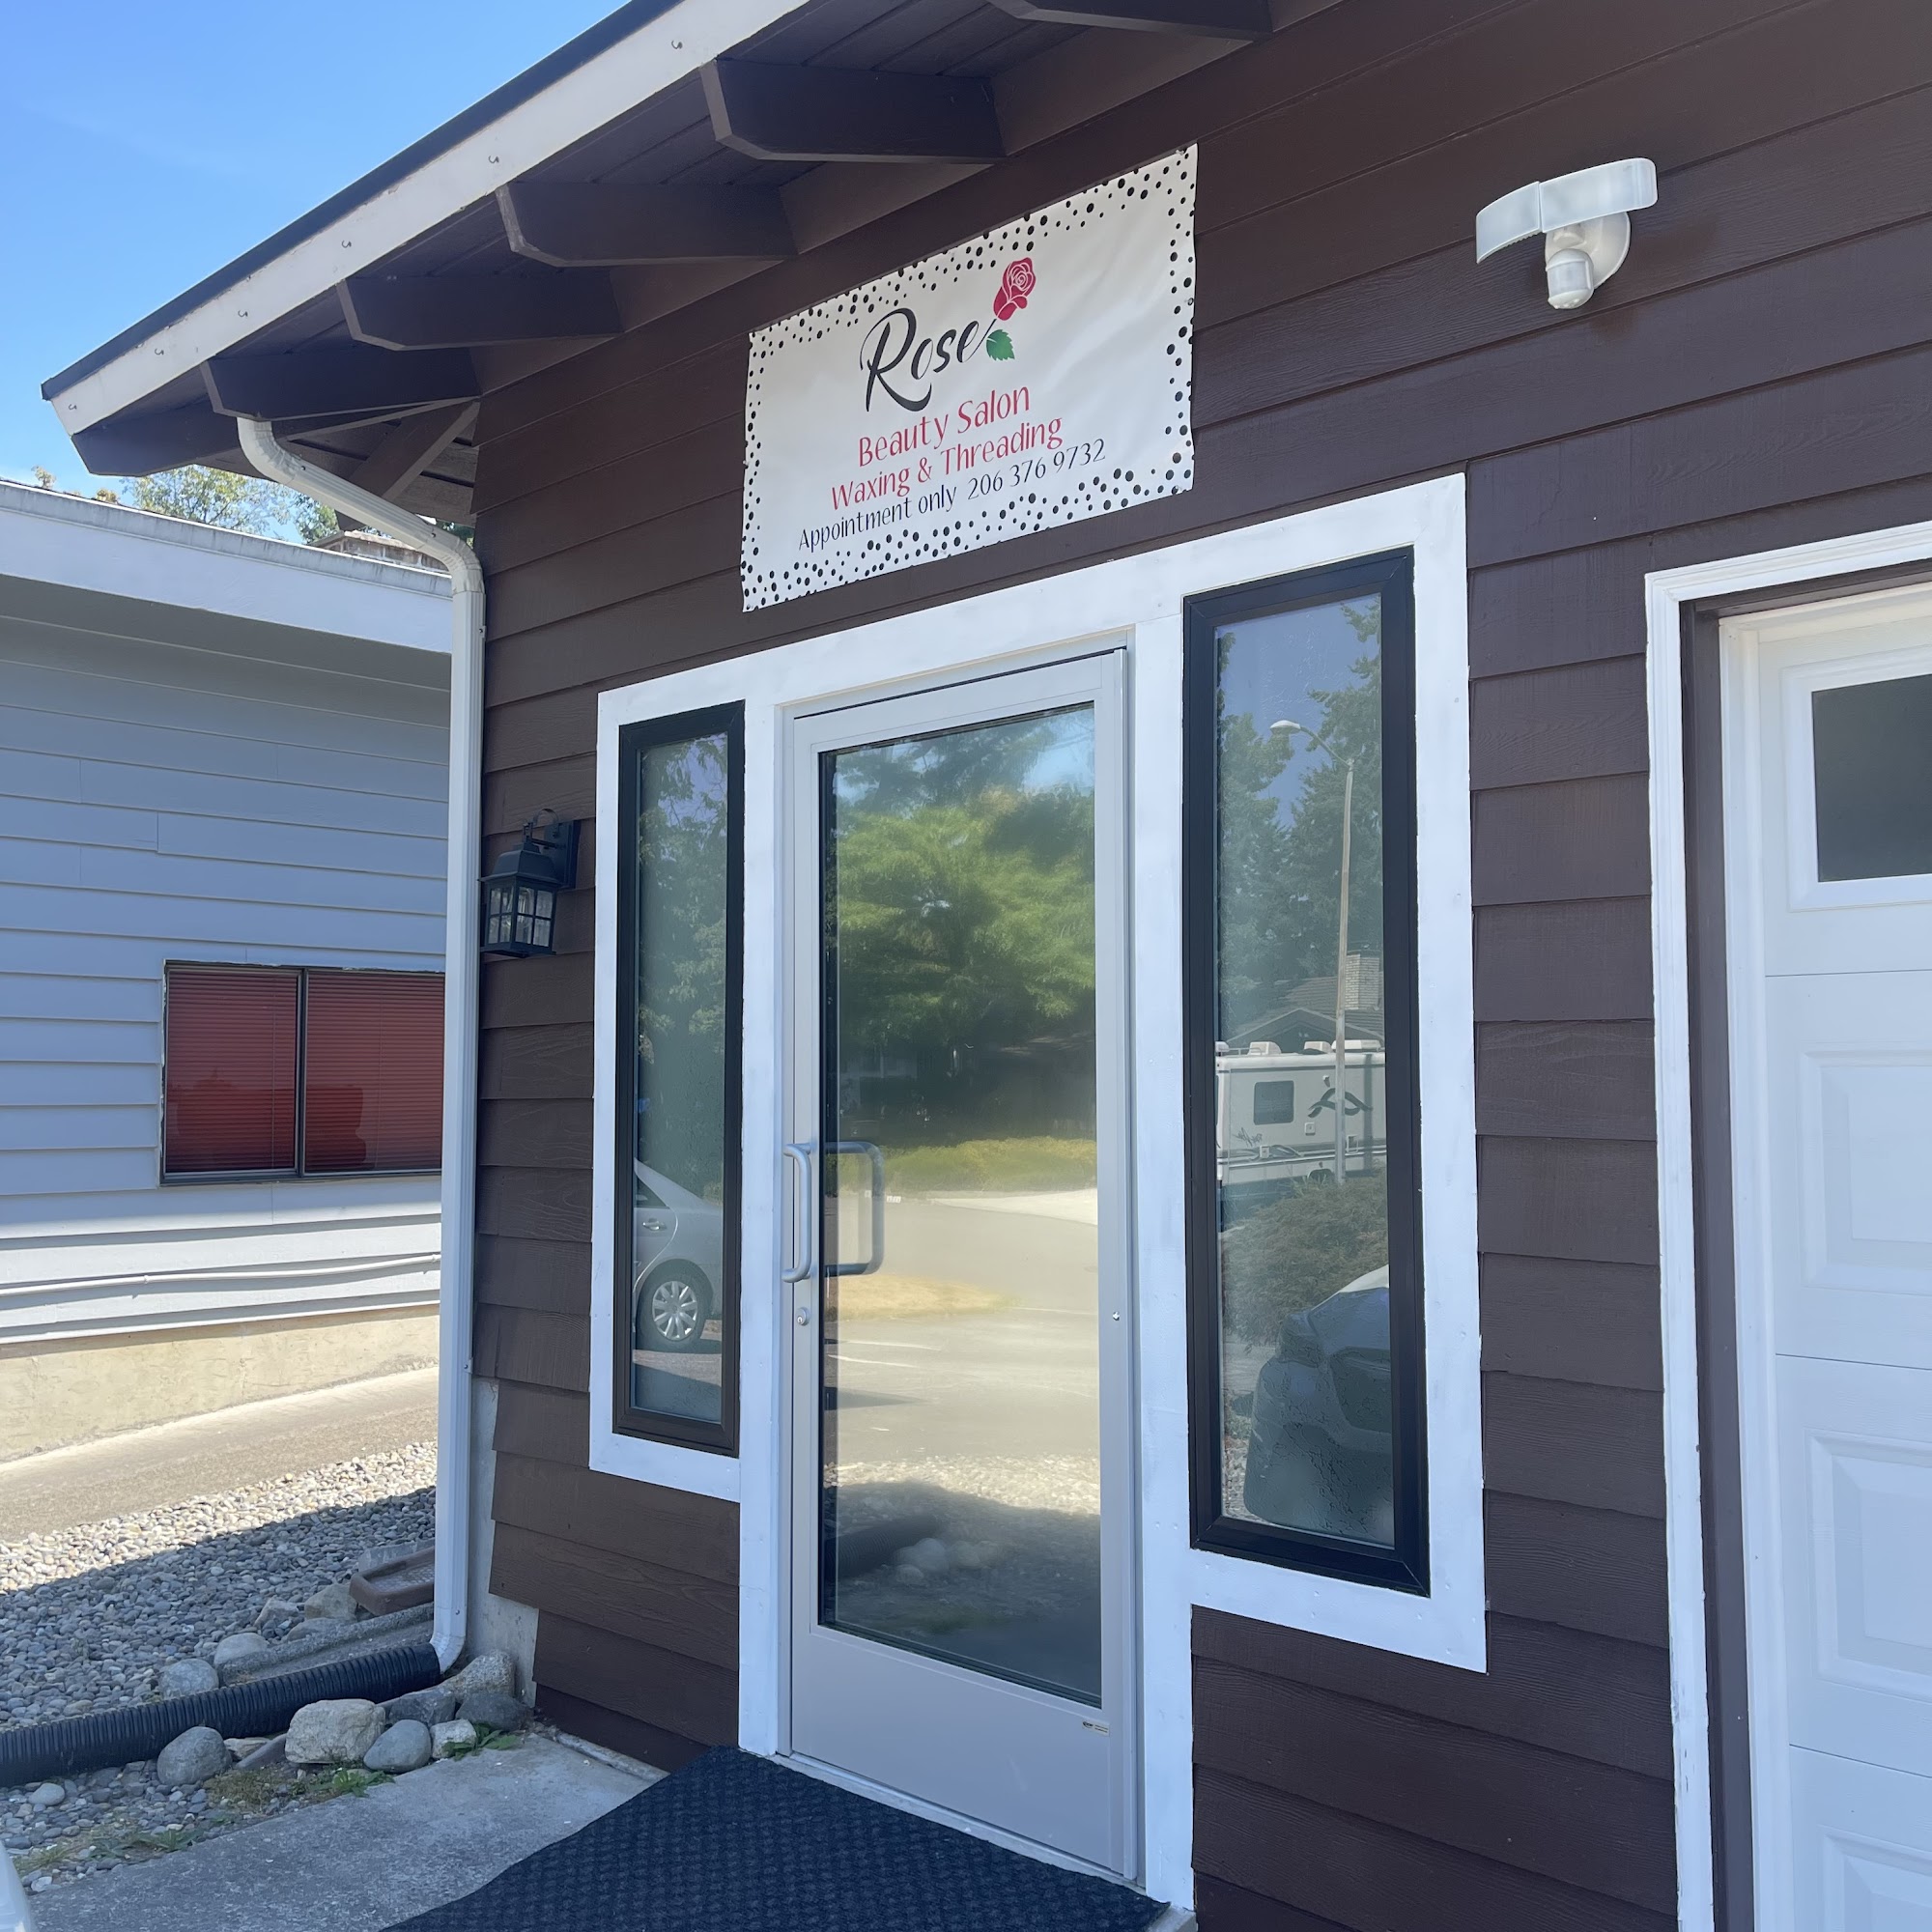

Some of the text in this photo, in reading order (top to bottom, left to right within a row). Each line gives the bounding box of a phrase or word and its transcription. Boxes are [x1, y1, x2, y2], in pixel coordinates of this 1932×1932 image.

[859, 307, 994, 412] Rose
[832, 417, 1064, 510] Waxing & Threading
[859, 386, 1030, 468] Beauty Salon
[799, 438, 1106, 554] Appointment only 206 376 9732
